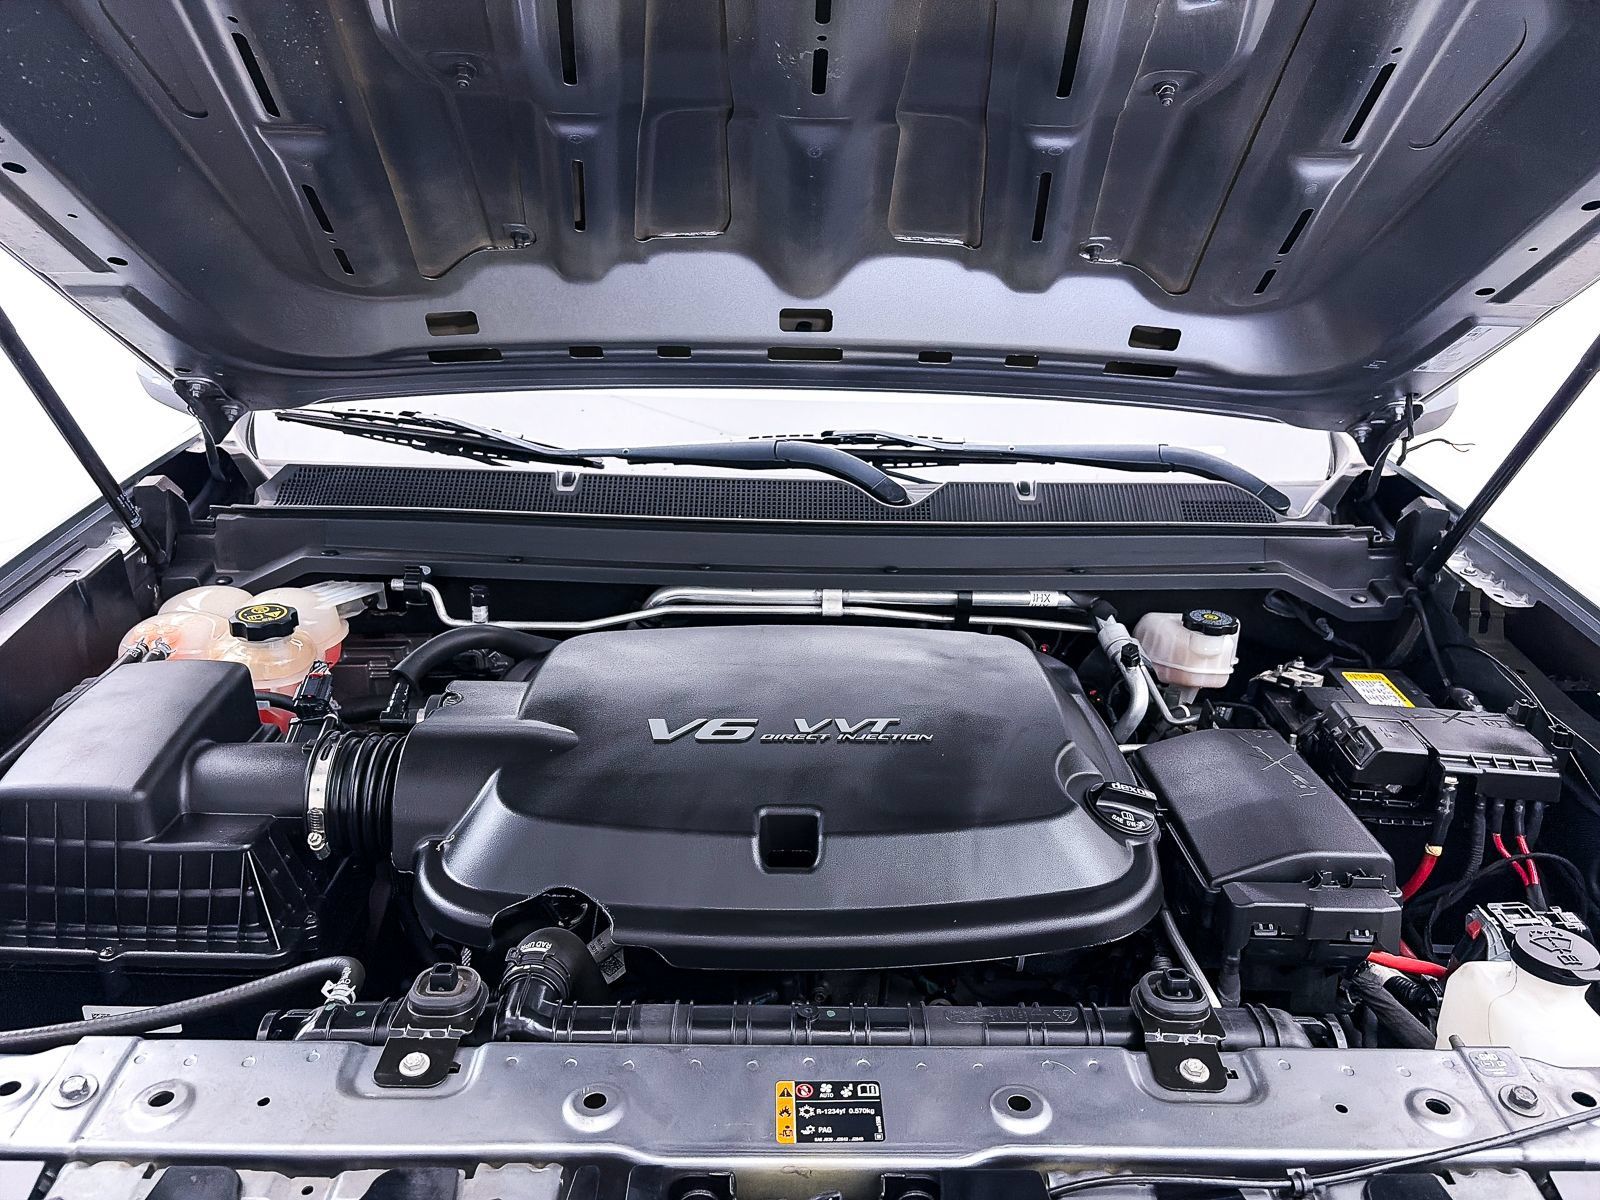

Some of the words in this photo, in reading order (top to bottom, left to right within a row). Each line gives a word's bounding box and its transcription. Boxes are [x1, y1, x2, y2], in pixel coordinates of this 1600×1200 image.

[648, 718, 759, 742] V6
[792, 718, 901, 733] VVT
[759, 733, 831, 742] DIRECT
[836, 733, 934, 742] INJECTION
